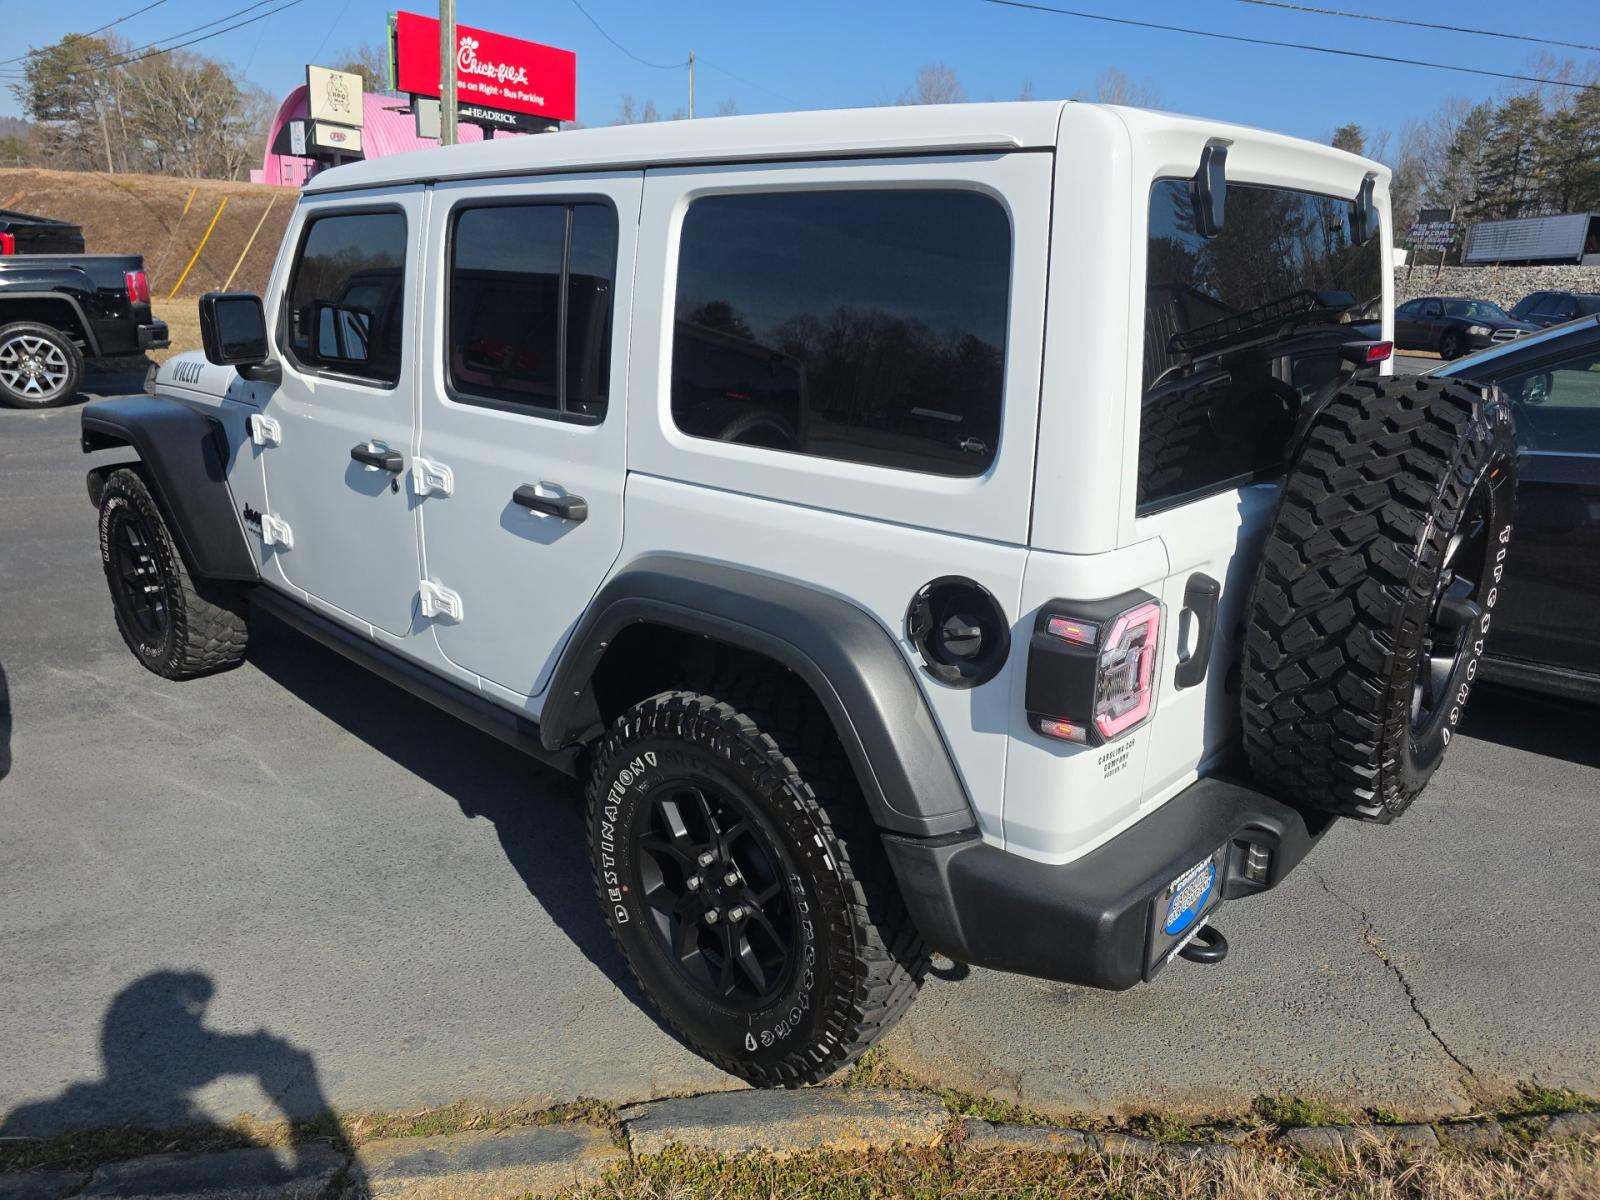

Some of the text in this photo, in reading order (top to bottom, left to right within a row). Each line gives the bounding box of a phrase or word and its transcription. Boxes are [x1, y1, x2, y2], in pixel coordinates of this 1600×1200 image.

[457, 42, 529, 85] Chick-fil-A
[467, 83, 478, 91] on
[479, 84, 498, 96] Right
[503, 88, 517, 99] Bus
[518, 91, 545, 107] Parking
[469, 107, 517, 124] HEADRICK
[599, 755, 647, 926] DESTINATION
